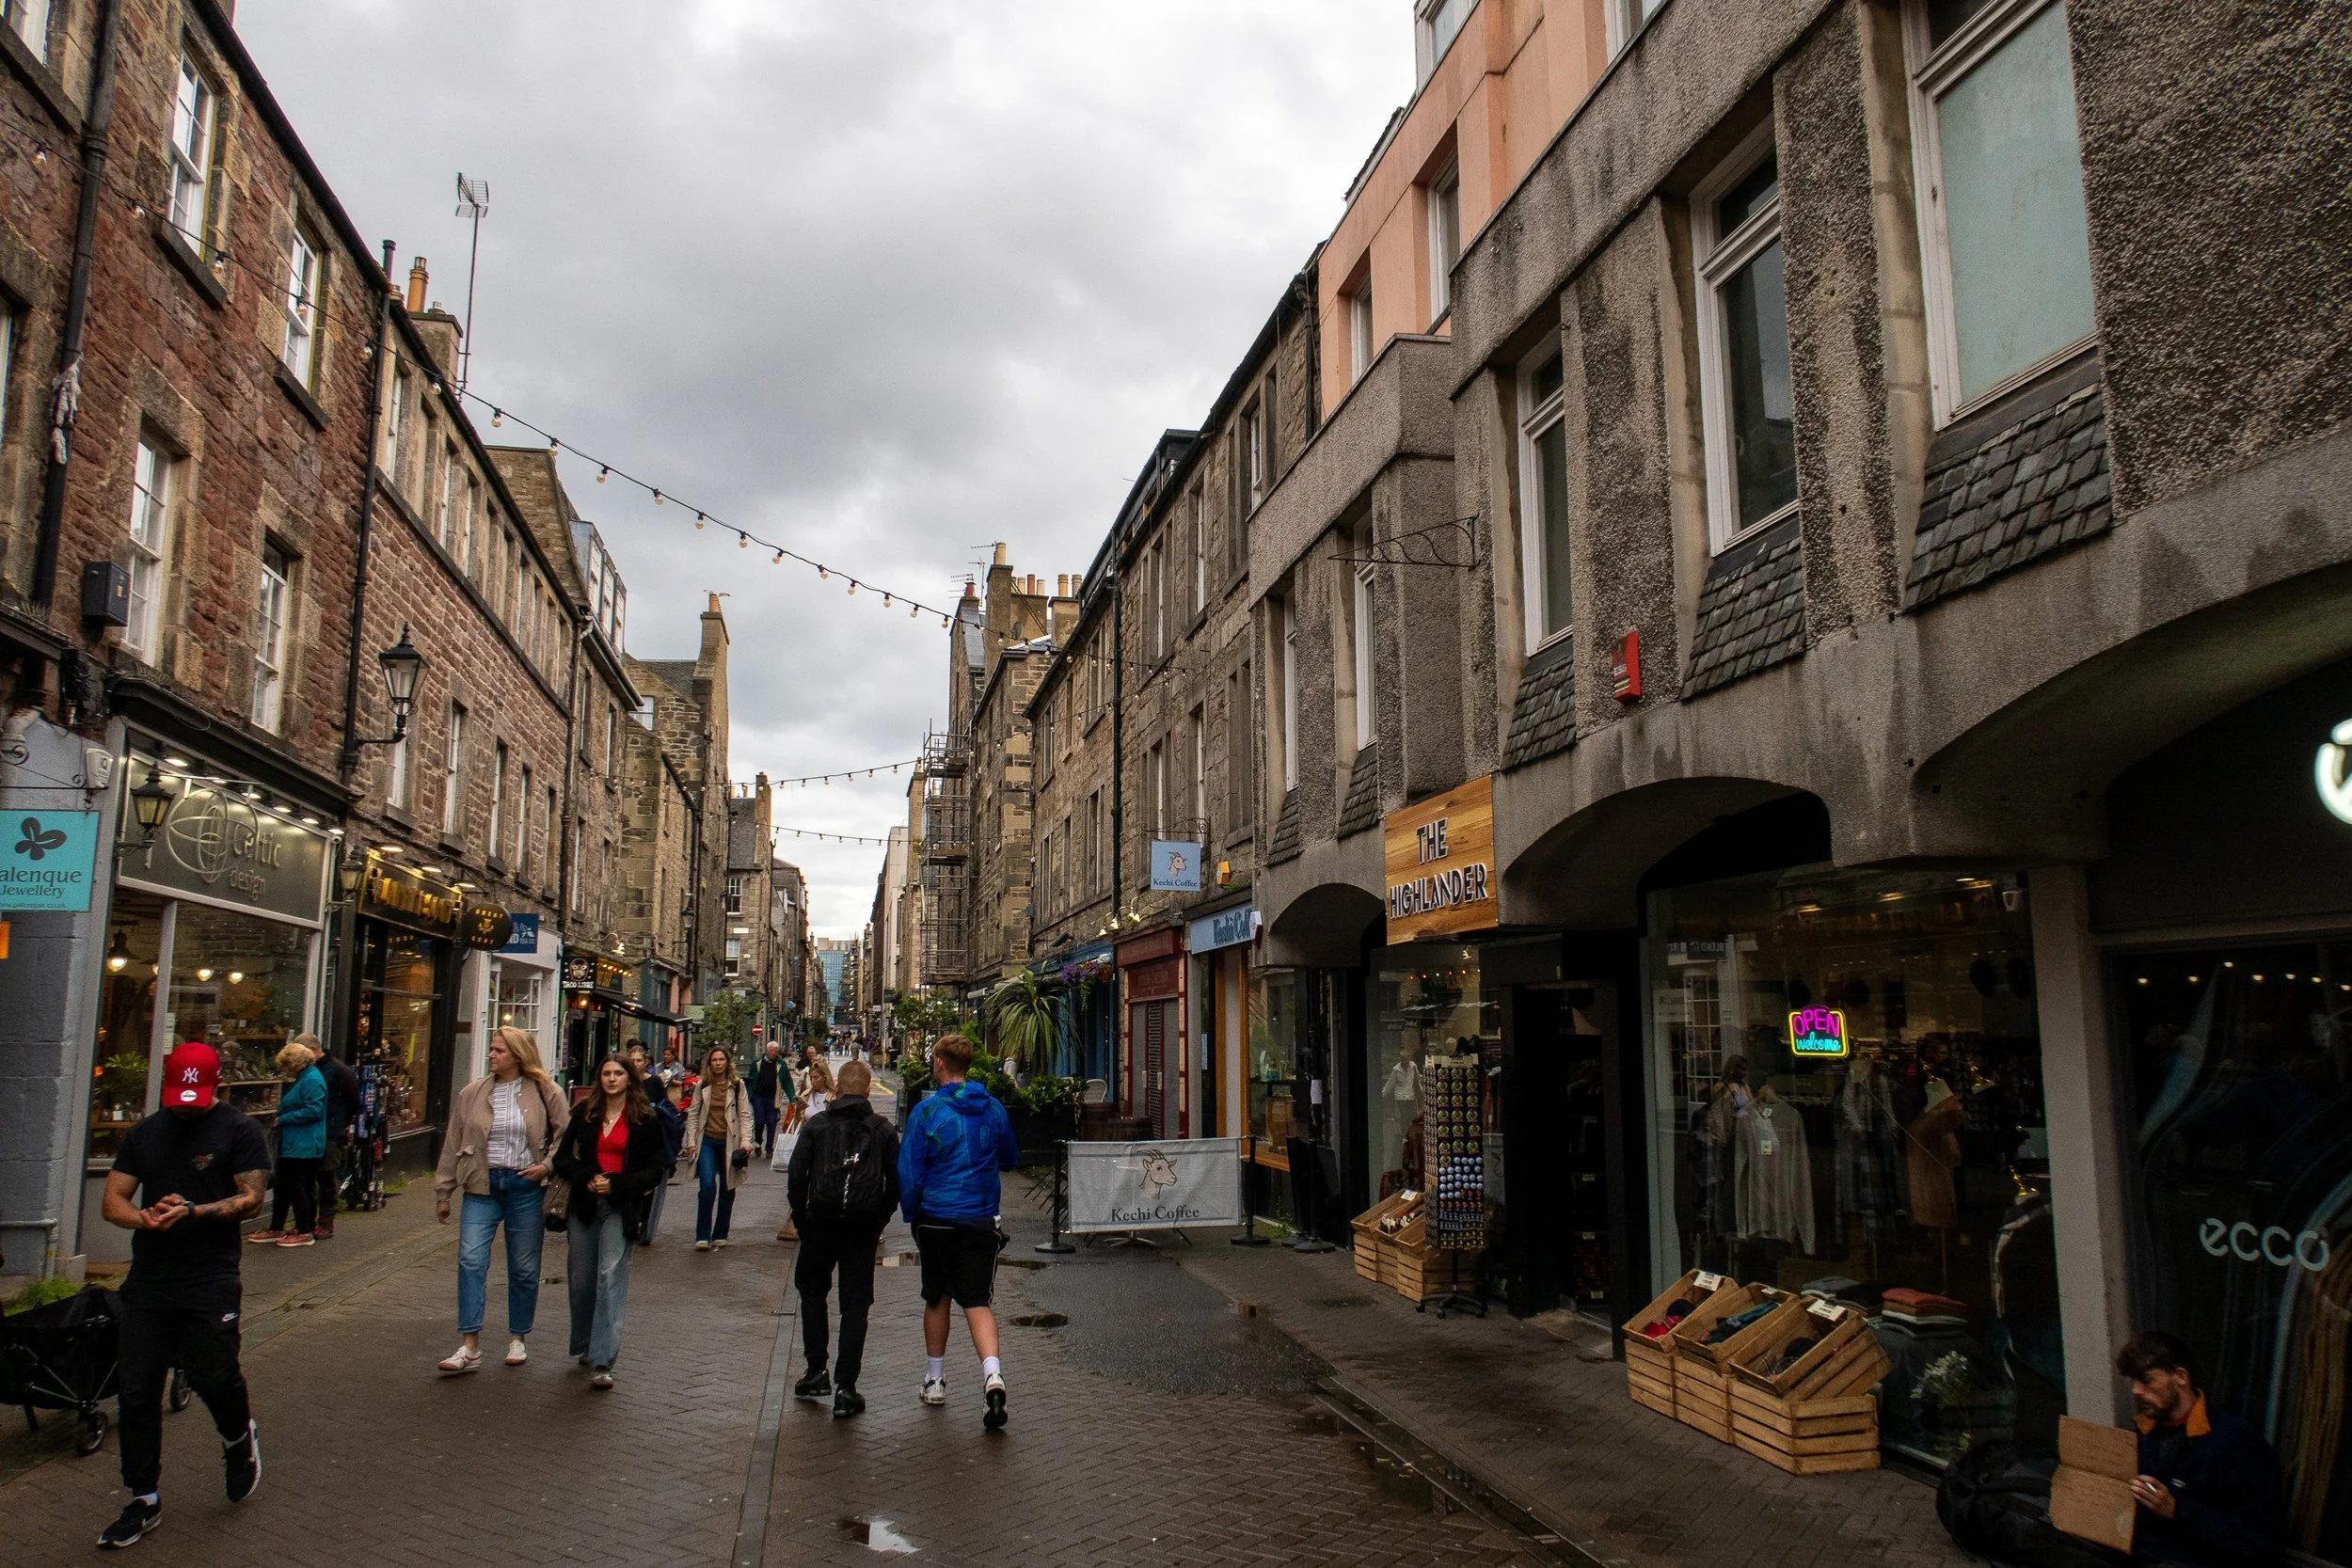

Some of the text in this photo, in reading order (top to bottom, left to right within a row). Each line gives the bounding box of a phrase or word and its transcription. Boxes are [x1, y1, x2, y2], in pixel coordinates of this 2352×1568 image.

[233, 819, 281, 867] Celtic
[1416, 817, 1449, 864] THE
[0, 866, 82, 887] alenque
[1, 884, 65, 898] Jewellery
[229, 867, 266, 901] design
[1152, 878, 1198, 888] Kechi Coffee
[1390, 863, 1488, 919] HIGHLANDER
[1213, 914, 1234, 946] Kechi
[1792, 1008, 1840, 1037] OPEN
[1796, 1031, 1841, 1052] welcome
[1111, 1205, 1200, 1222] Kechi Coffee
[2200, 1217, 2329, 1272] ecco
